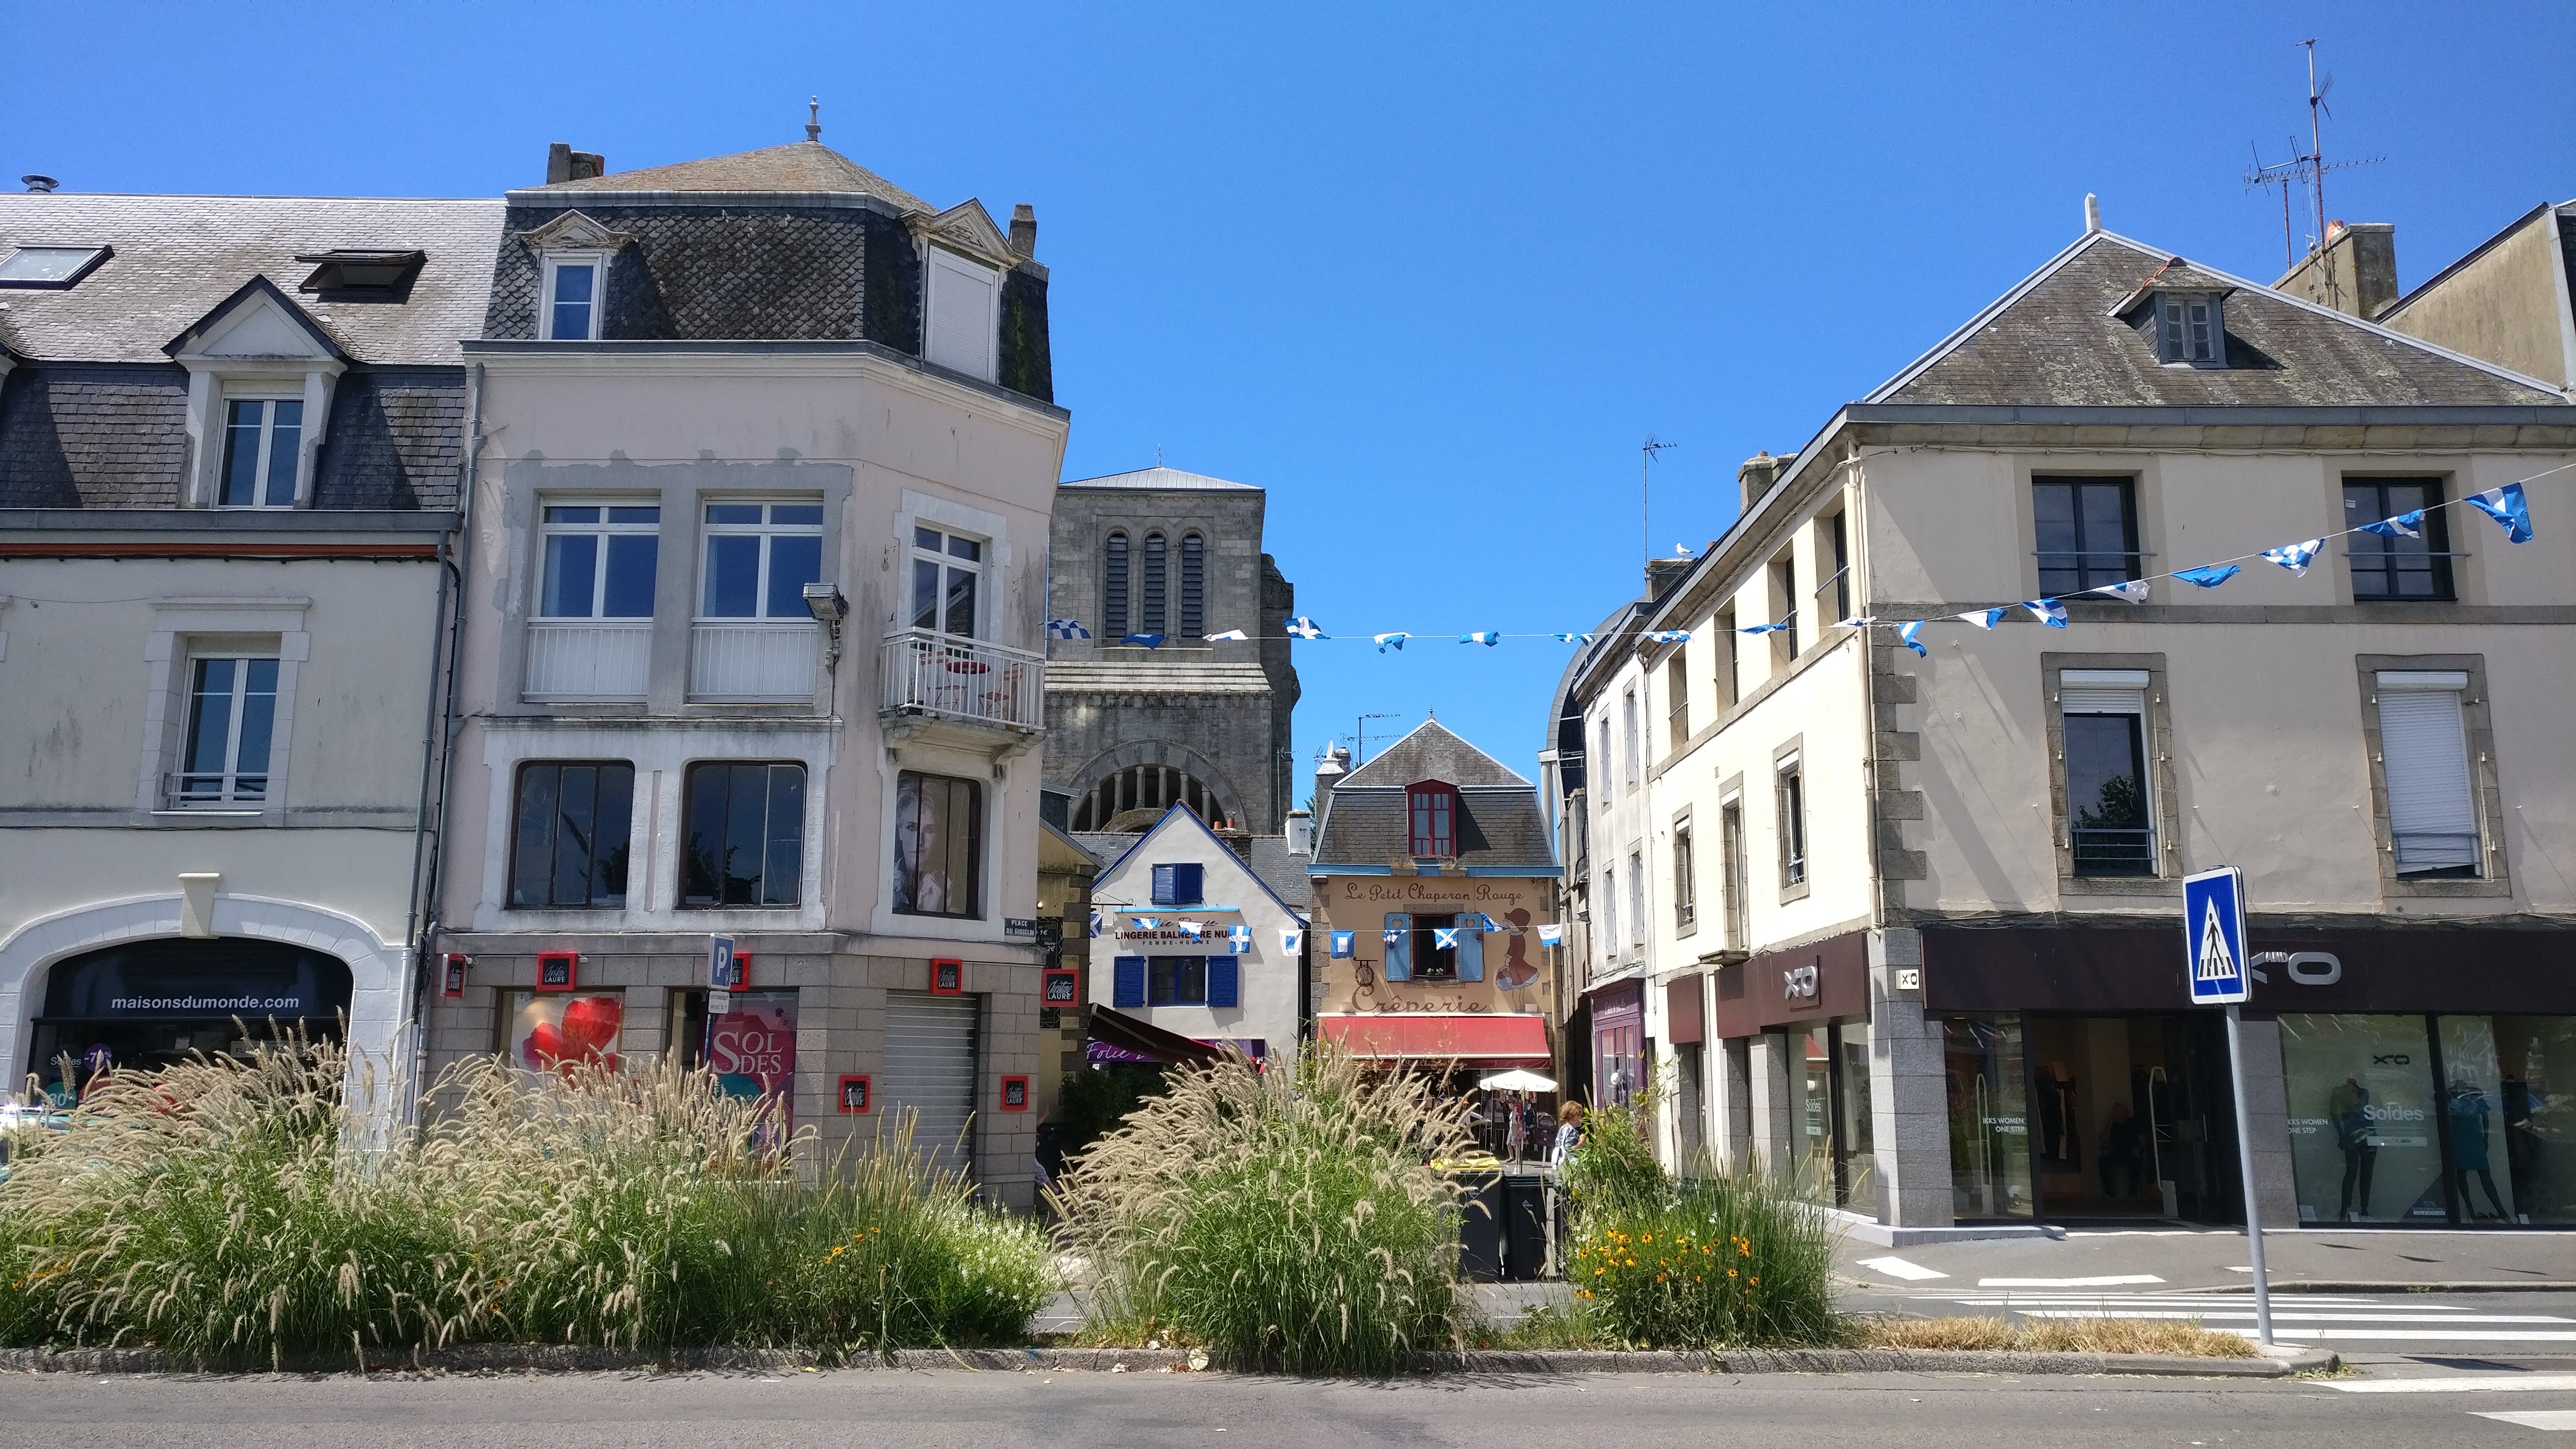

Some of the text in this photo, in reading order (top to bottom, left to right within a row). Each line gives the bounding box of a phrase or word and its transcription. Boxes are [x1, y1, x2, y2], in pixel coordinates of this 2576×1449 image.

[1345, 882, 1525, 906] Le Petit Chaperon Rouge
[1115, 931, 1158, 940] LINGERIE
[1160, 930, 1212, 939] BALNERE
[716, 946, 727, 977] P
[111, 995, 299, 1009] maisonsdumonde.com
[1351, 984, 1487, 1013] Crêperie
[1086, 1041, 1131, 1060] Folie
[2363, 1105, 2424, 1121] Soldes
